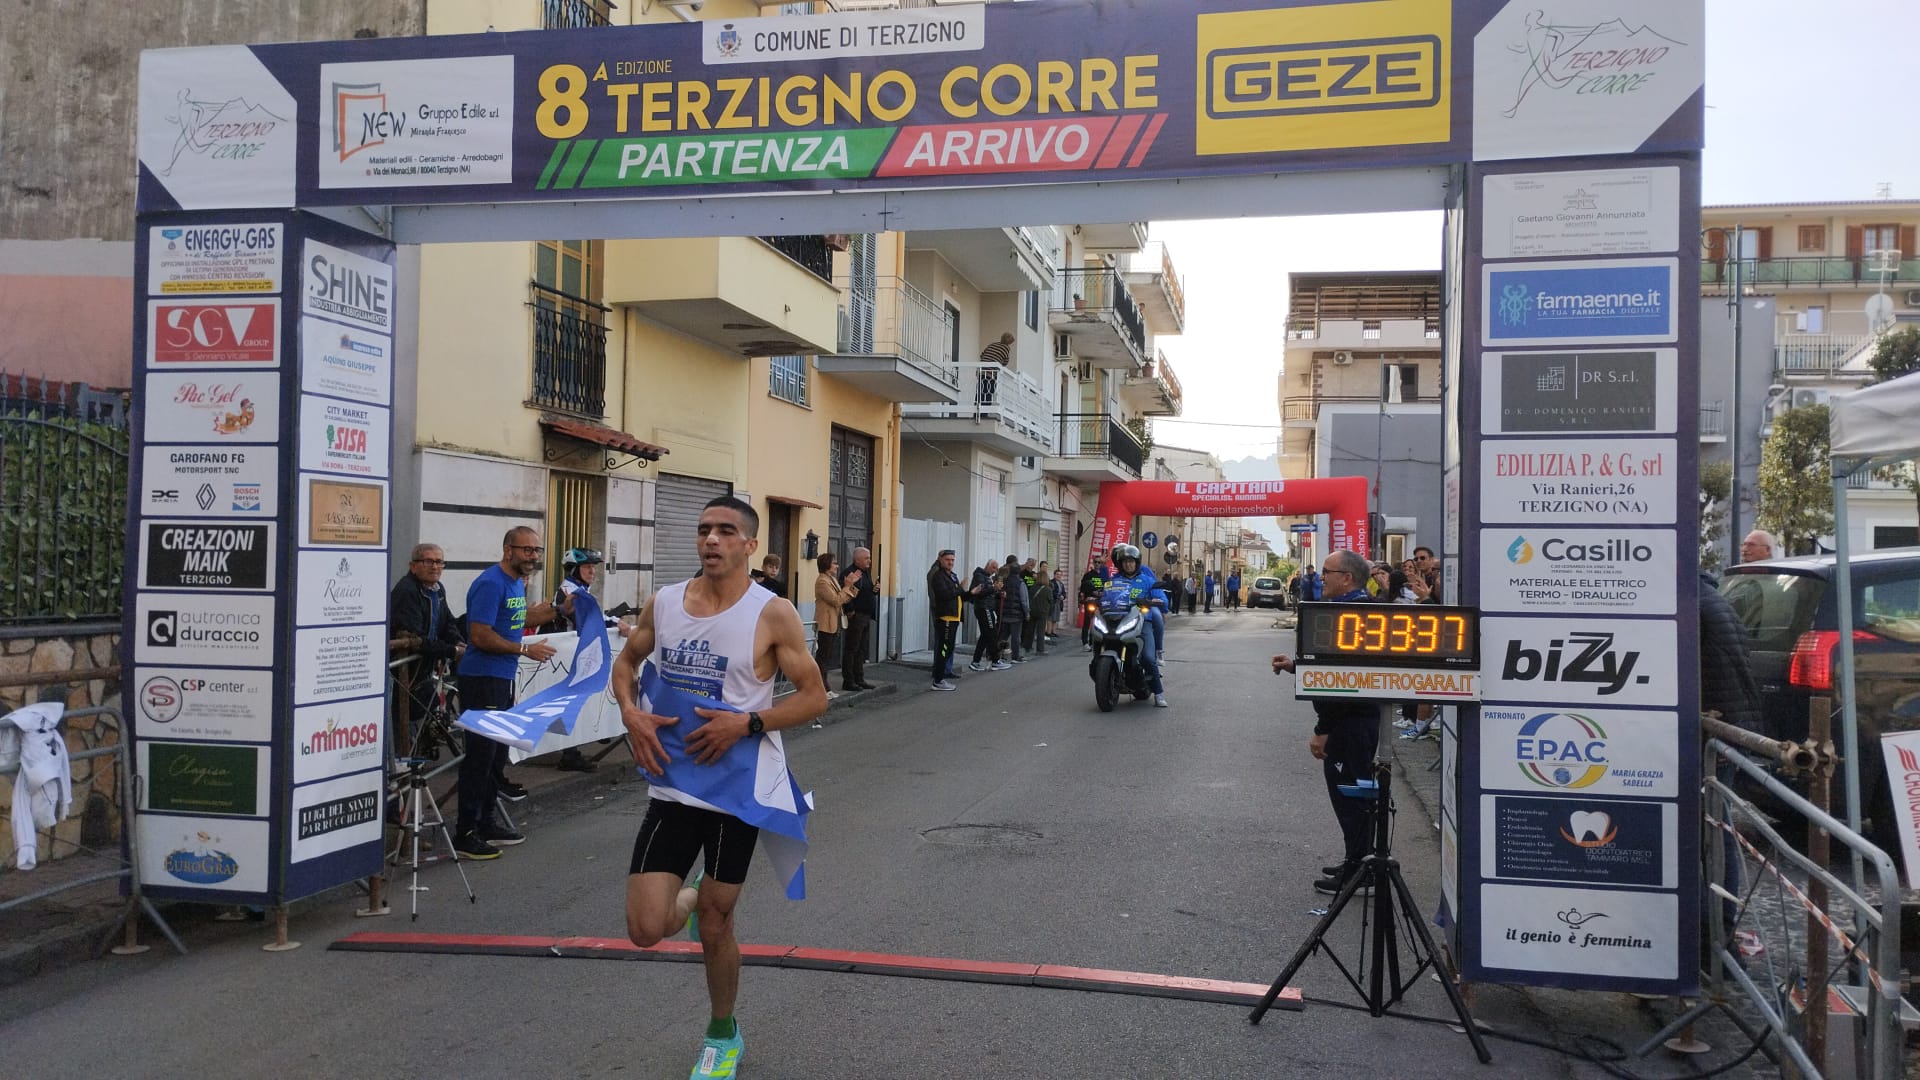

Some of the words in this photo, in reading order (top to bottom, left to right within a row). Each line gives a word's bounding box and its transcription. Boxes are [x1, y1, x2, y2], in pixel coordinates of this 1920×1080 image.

[754, 28, 831, 52] COMUNE
[840, 27, 858, 47] DI
[867, 20, 966, 47] TERZIGNO
[616, 60, 672, 76] EDIZIONE
[1563, 47, 1670, 71] TERZIGNO
[1224, 51, 1421, 103] GEZE
[607, 70, 917, 132] TERZIGNO
[940, 54, 1159, 118] CORRE
[418, 104, 458, 124] Gruppo
[361, 112, 406, 146] NEW
[904, 124, 1090, 167] ARRIVO
[419, 155, 455, 163] Ceramiche
[462, 153, 504, 162] Arredobagni
[618, 136, 849, 179] PARTENZA
[437, 165, 458, 175] Terzigno
[1517, 214, 1554, 224] Gaetano
[1556, 212, 1594, 222] Giovanni
[1596, 211, 1646, 220] Annunziata
[185, 227, 275, 250] ENERGY-GAS
[311, 254, 388, 315] SHINE
[1536, 288, 1661, 309] farmaenne.it
[342, 305, 387, 325] ABBIGLIAMENTO
[167, 307, 255, 347] SGV
[347, 359, 376, 373] GIUSEPPE
[1582, 372, 1602, 383] DR
[1608, 370, 1639, 383] S.r.l.
[326, 405, 341, 415] CITY
[342, 408, 368, 419] MARKET
[1534, 407, 1596, 415] DOMENICO
[334, 427, 367, 453] SISA
[170, 453, 228, 463] GAROFANO
[231, 454, 245, 463] FG
[1496, 453, 1576, 477] EDILIZIA
[1599, 453, 1613, 477] &
[1619, 453, 1637, 477] G.
[1642, 453, 1662, 476] srl
[1175, 482, 1190, 494] IL
[1196, 481, 1285, 494] CAPITANO
[1532, 483, 1555, 495] Via
[1561, 483, 1635, 497] Ranieri,26
[1175, 503, 1284, 515] www.ilcapitanoshop.it
[1519, 501, 1608, 513] TERZIGNO
[1612, 501, 1648, 515] (NA)
[161, 528, 255, 551] CREAZIONI
[1542, 538, 1652, 562] Casillo
[183, 551, 231, 572] MAIK
[180, 574, 232, 584] TERZIGNO
[1510, 578, 1576, 587] MATERIALE
[1579, 579, 1647, 588] ELETTRICO
[324, 578, 362, 603] Ranieri
[1518, 590, 1561, 599] TERMO
[1571, 591, 1637, 600] IDRAULICO
[181, 612, 260, 625] autronica
[180, 626, 260, 642] duraccio
[1337, 613, 1465, 652] 0:33:37
[677, 639, 710, 652] A.S.D.
[666, 649, 679, 663] IN
[683, 652, 718, 668] TIME
[695, 668, 711, 677] TEAM
[1302, 671, 1473, 691] CRONOMETROGARA.IT
[180, 679, 206, 691] CSP
[209, 681, 244, 693] center
[1484, 711, 1526, 720] PATRONATO
[301, 742, 310, 756] la
[311, 722, 378, 754] mimosa
[1517, 739, 1609, 763] E.P.A.C.
[1612, 769, 1637, 778] MARIA
[1637, 770, 1664, 779] GRAZIA
[1622, 778, 1653, 787] SABELLA
[329, 803, 343, 817] DEL
[302, 808, 374, 836] PARRUCCHIERI
[1506, 928, 1517, 940] il
[1520, 931, 1562, 944] genio
[1568, 932, 1576, 944] è
[1580, 933, 1652, 949] femmina
